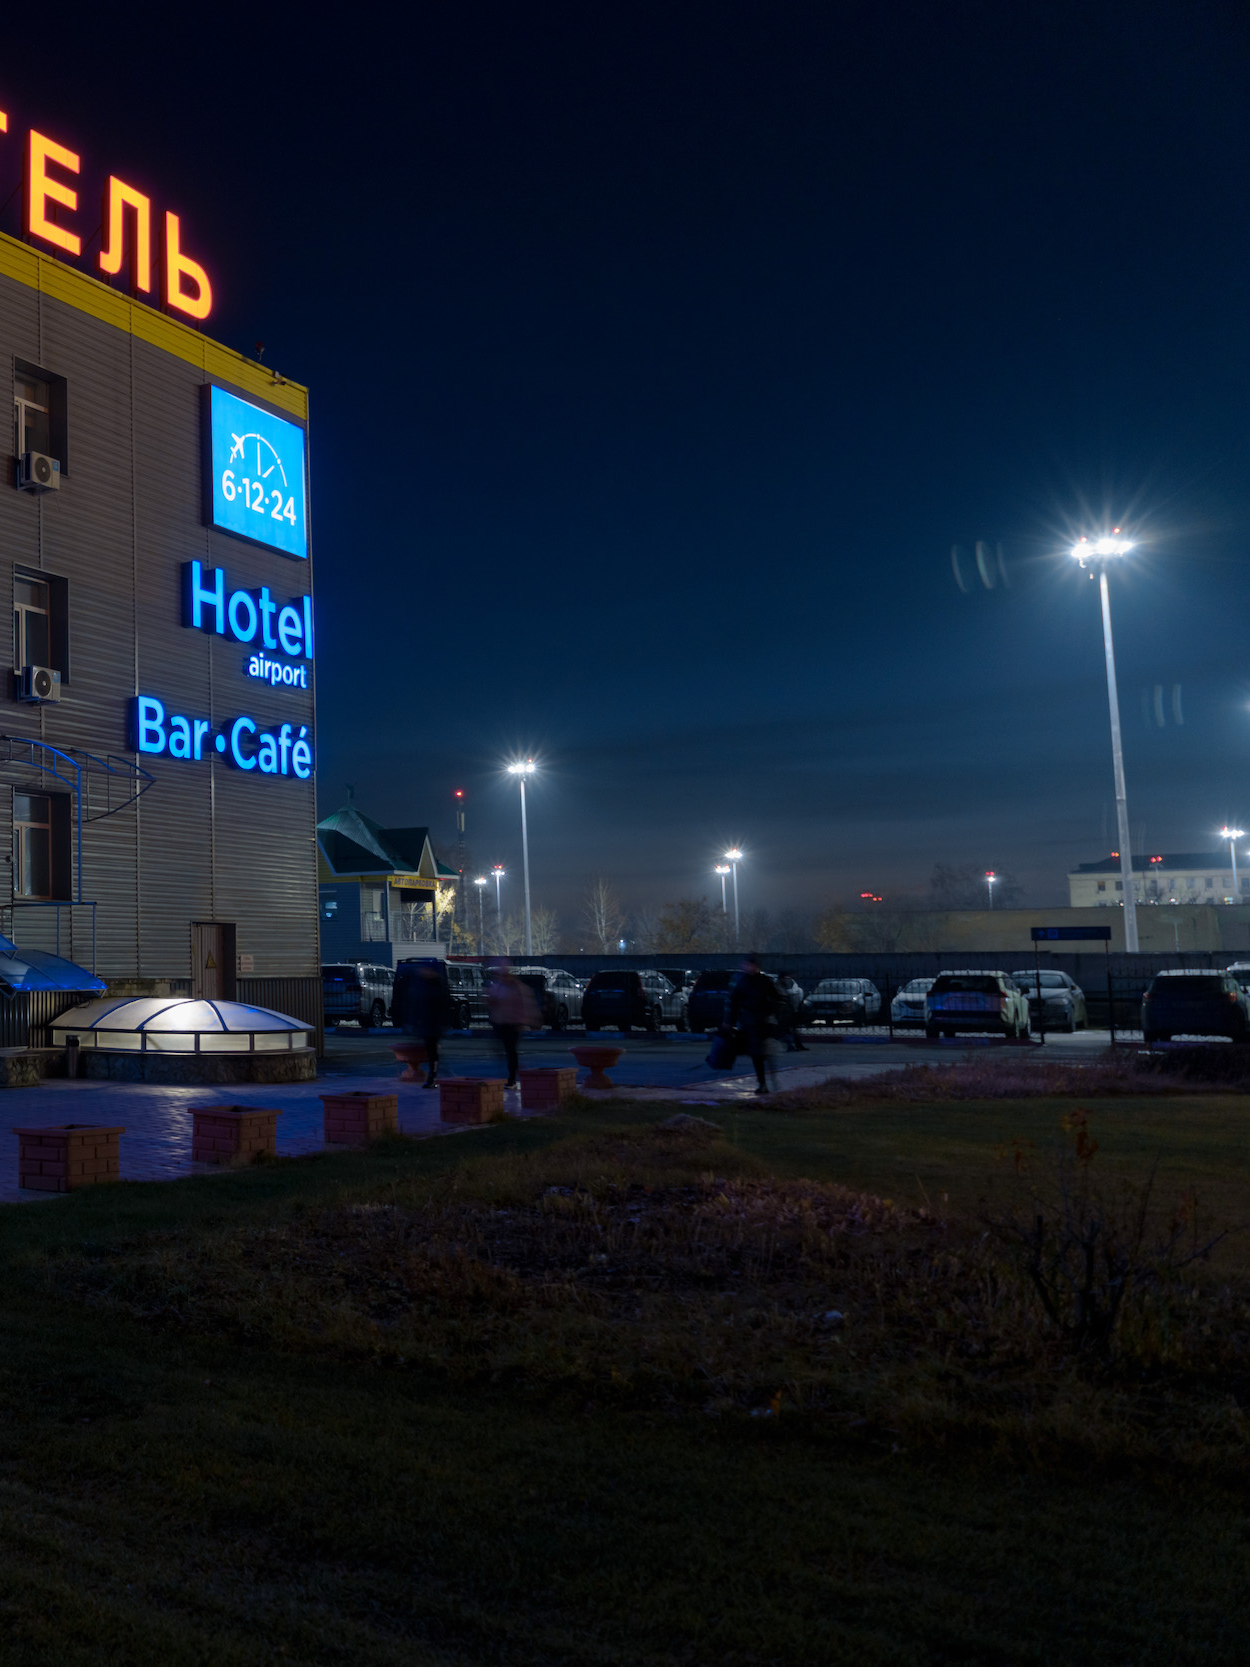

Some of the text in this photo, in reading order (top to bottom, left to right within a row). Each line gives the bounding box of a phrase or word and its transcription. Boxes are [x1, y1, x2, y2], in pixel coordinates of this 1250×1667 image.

[191, 560, 313, 659] Hotel
[249, 653, 307, 689] airport
[394, 877, 436, 888] АВТОПАРКОВКА
